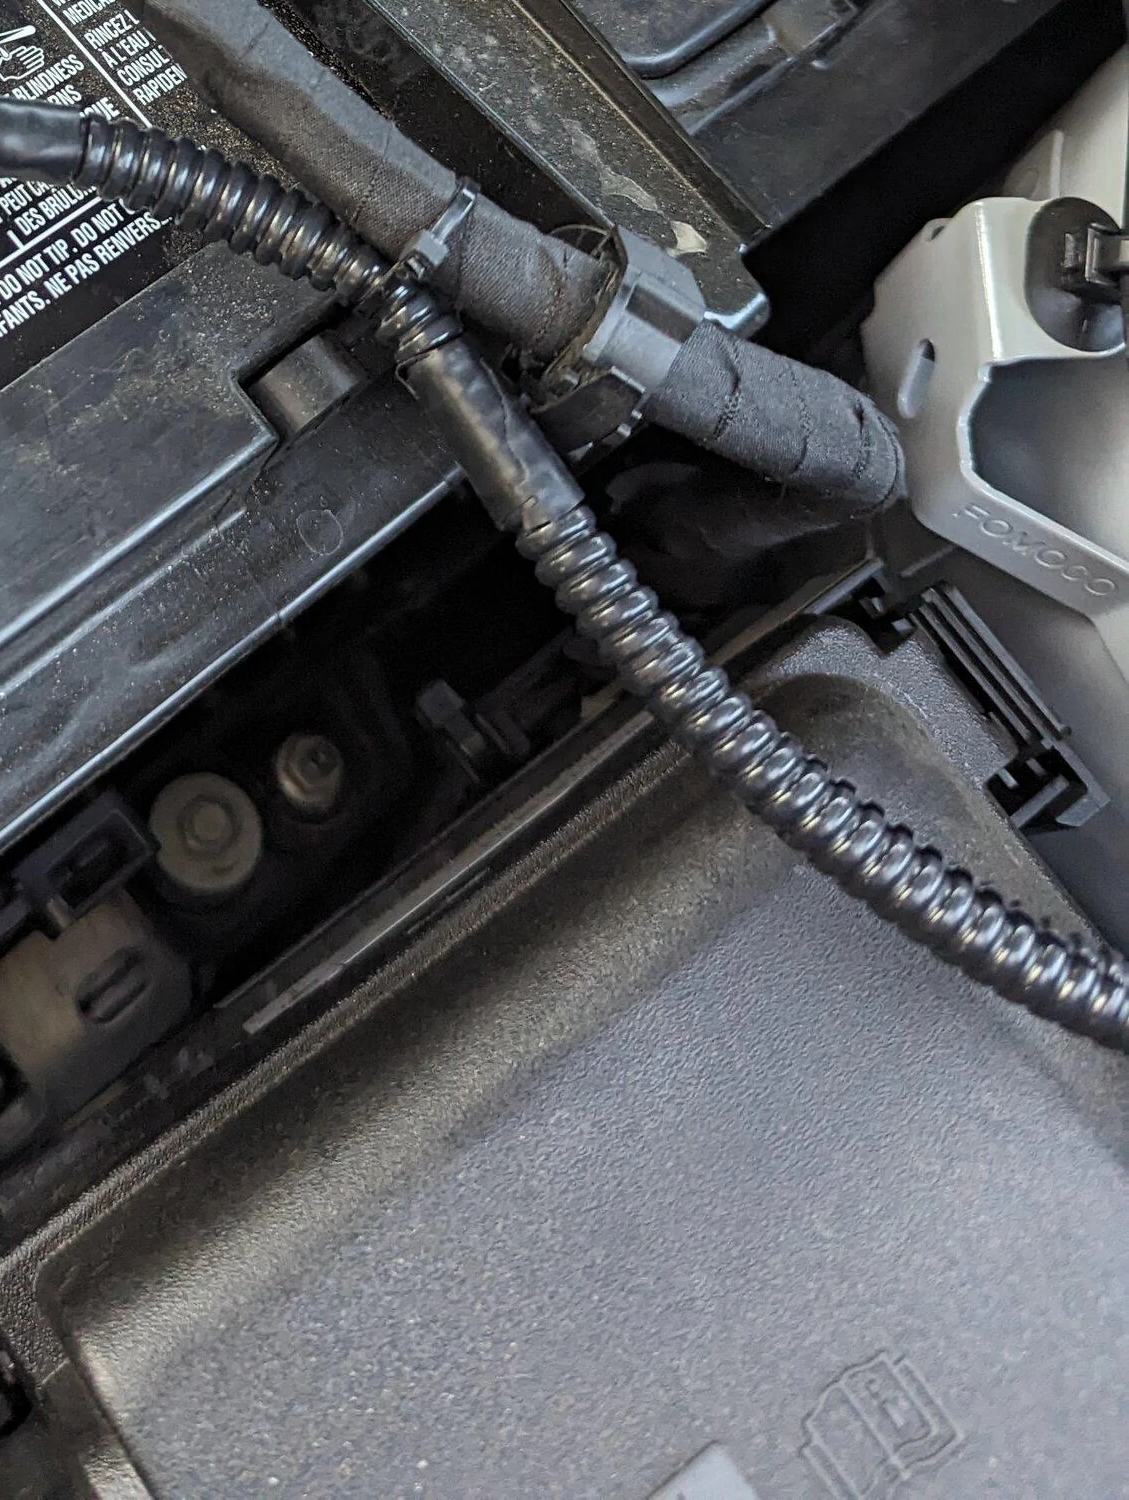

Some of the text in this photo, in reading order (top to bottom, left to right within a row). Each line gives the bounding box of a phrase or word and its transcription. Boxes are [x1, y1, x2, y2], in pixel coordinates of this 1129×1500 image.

[83, 13, 132, 49] RINCEZ
[97, 29, 149, 69] À L'EAU
[11, 53, 84, 100] BLINDNESS
[14, 207, 45, 235] DES
[15, 252, 49, 285] NOT
[42, 238, 77, 264] TIP.
[70, 221, 97, 247] DO
[90, 202, 124, 233] NOT
[43, 271, 72, 298] NE
[64, 252, 99, 284] PAS
[92, 211, 172, 264] RENVERS
[949, 501, 1119, 598] FOMOCO
